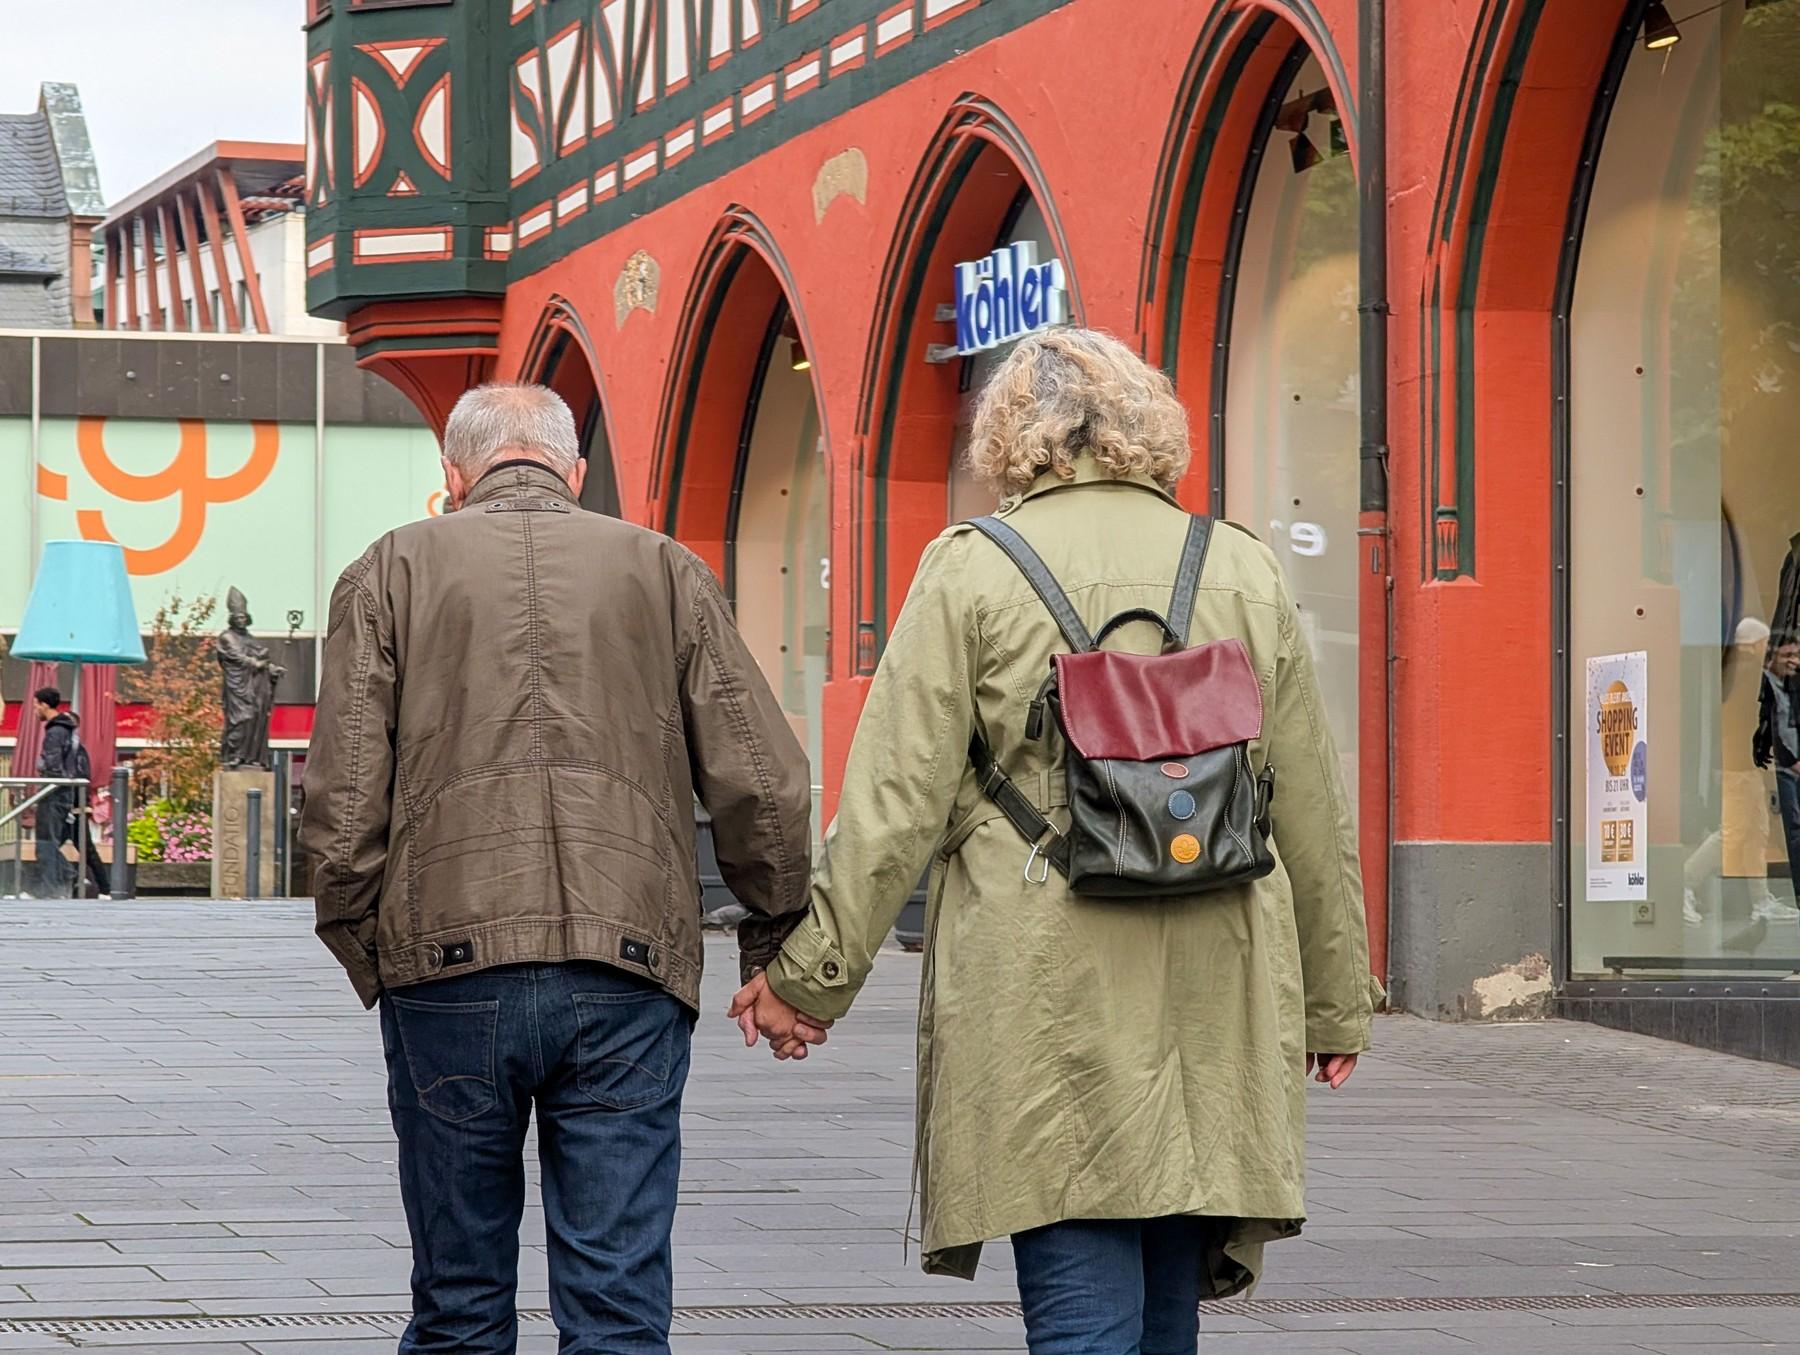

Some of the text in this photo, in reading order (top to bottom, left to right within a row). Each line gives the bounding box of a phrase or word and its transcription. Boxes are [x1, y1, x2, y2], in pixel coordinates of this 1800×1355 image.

[954, 243, 1058, 353] köhler
[1596, 707, 1638, 734] SHOPPING
[1604, 732, 1630, 757] EVENT
